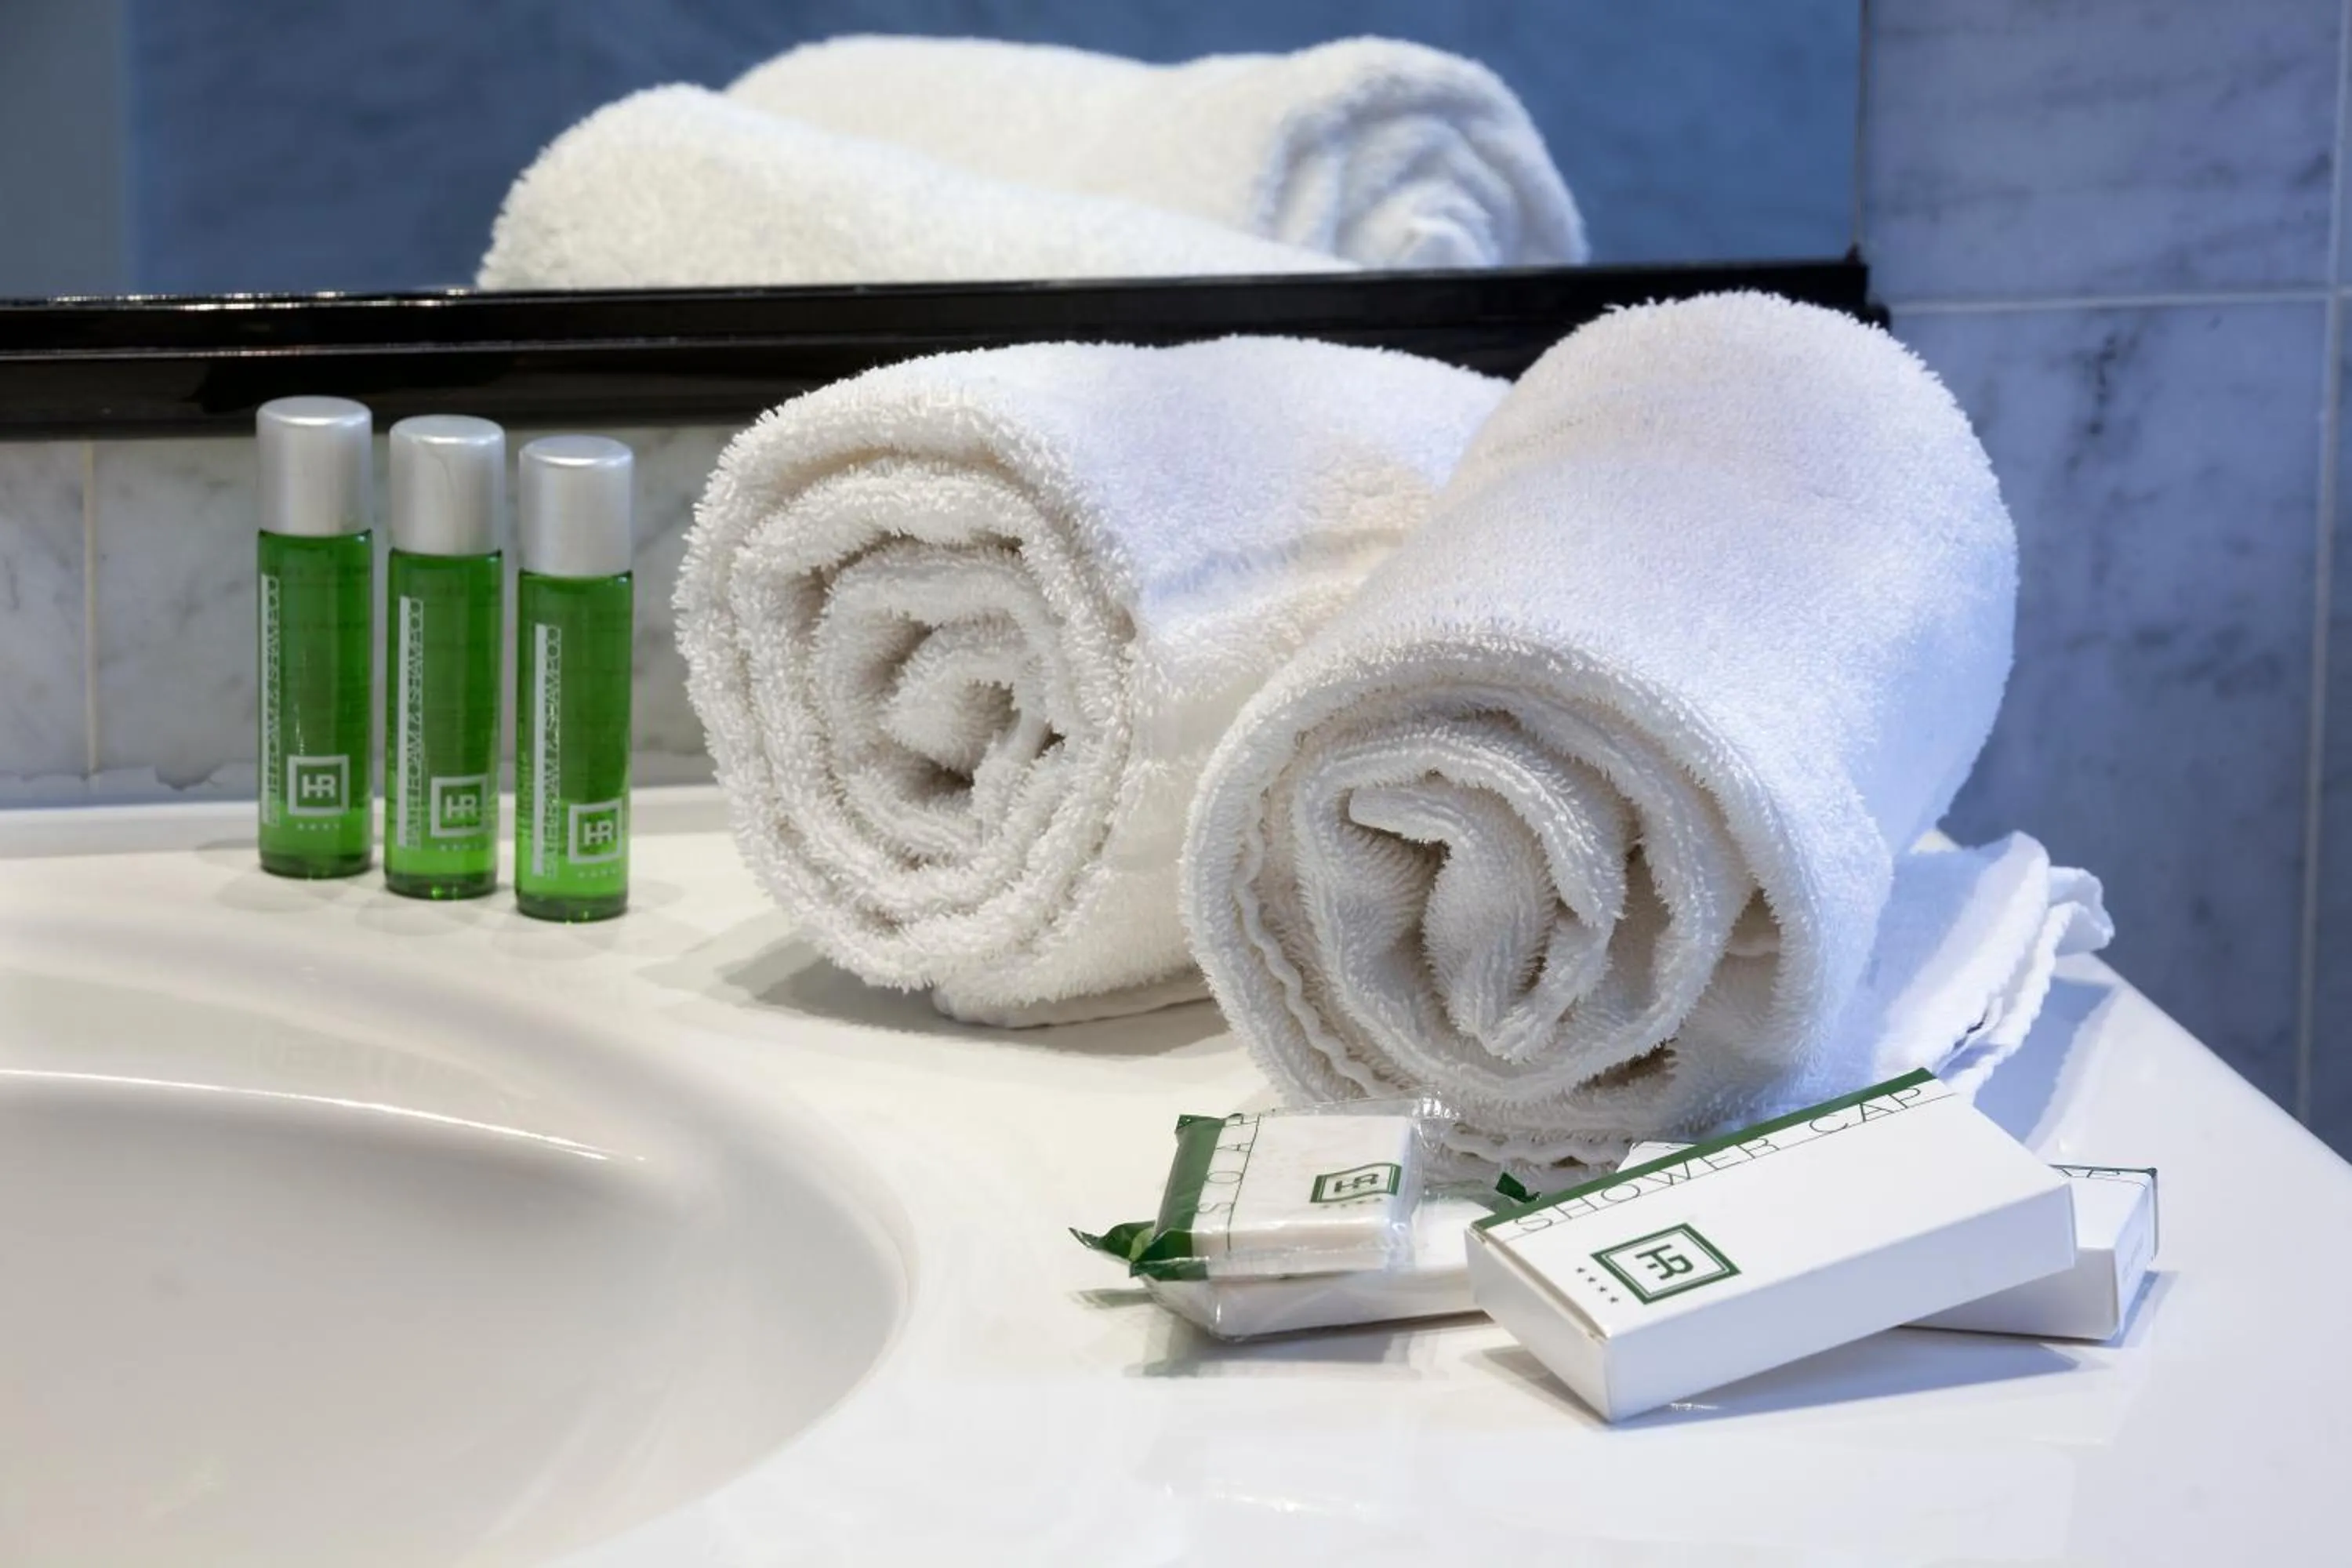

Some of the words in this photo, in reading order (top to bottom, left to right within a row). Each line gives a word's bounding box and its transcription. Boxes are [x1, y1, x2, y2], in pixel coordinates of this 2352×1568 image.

[301, 773, 336, 799] HR
[445, 793, 477, 820] HR
[584, 819, 613, 845] HR
[1196, 1112, 1258, 1214] SOAP
[1515, 1137, 1780, 1232] SHOWER
[1809, 1087, 1922, 1134] CAP
[1334, 1173, 1379, 1192] HR
[1635, 1243, 1694, 1280] HR
